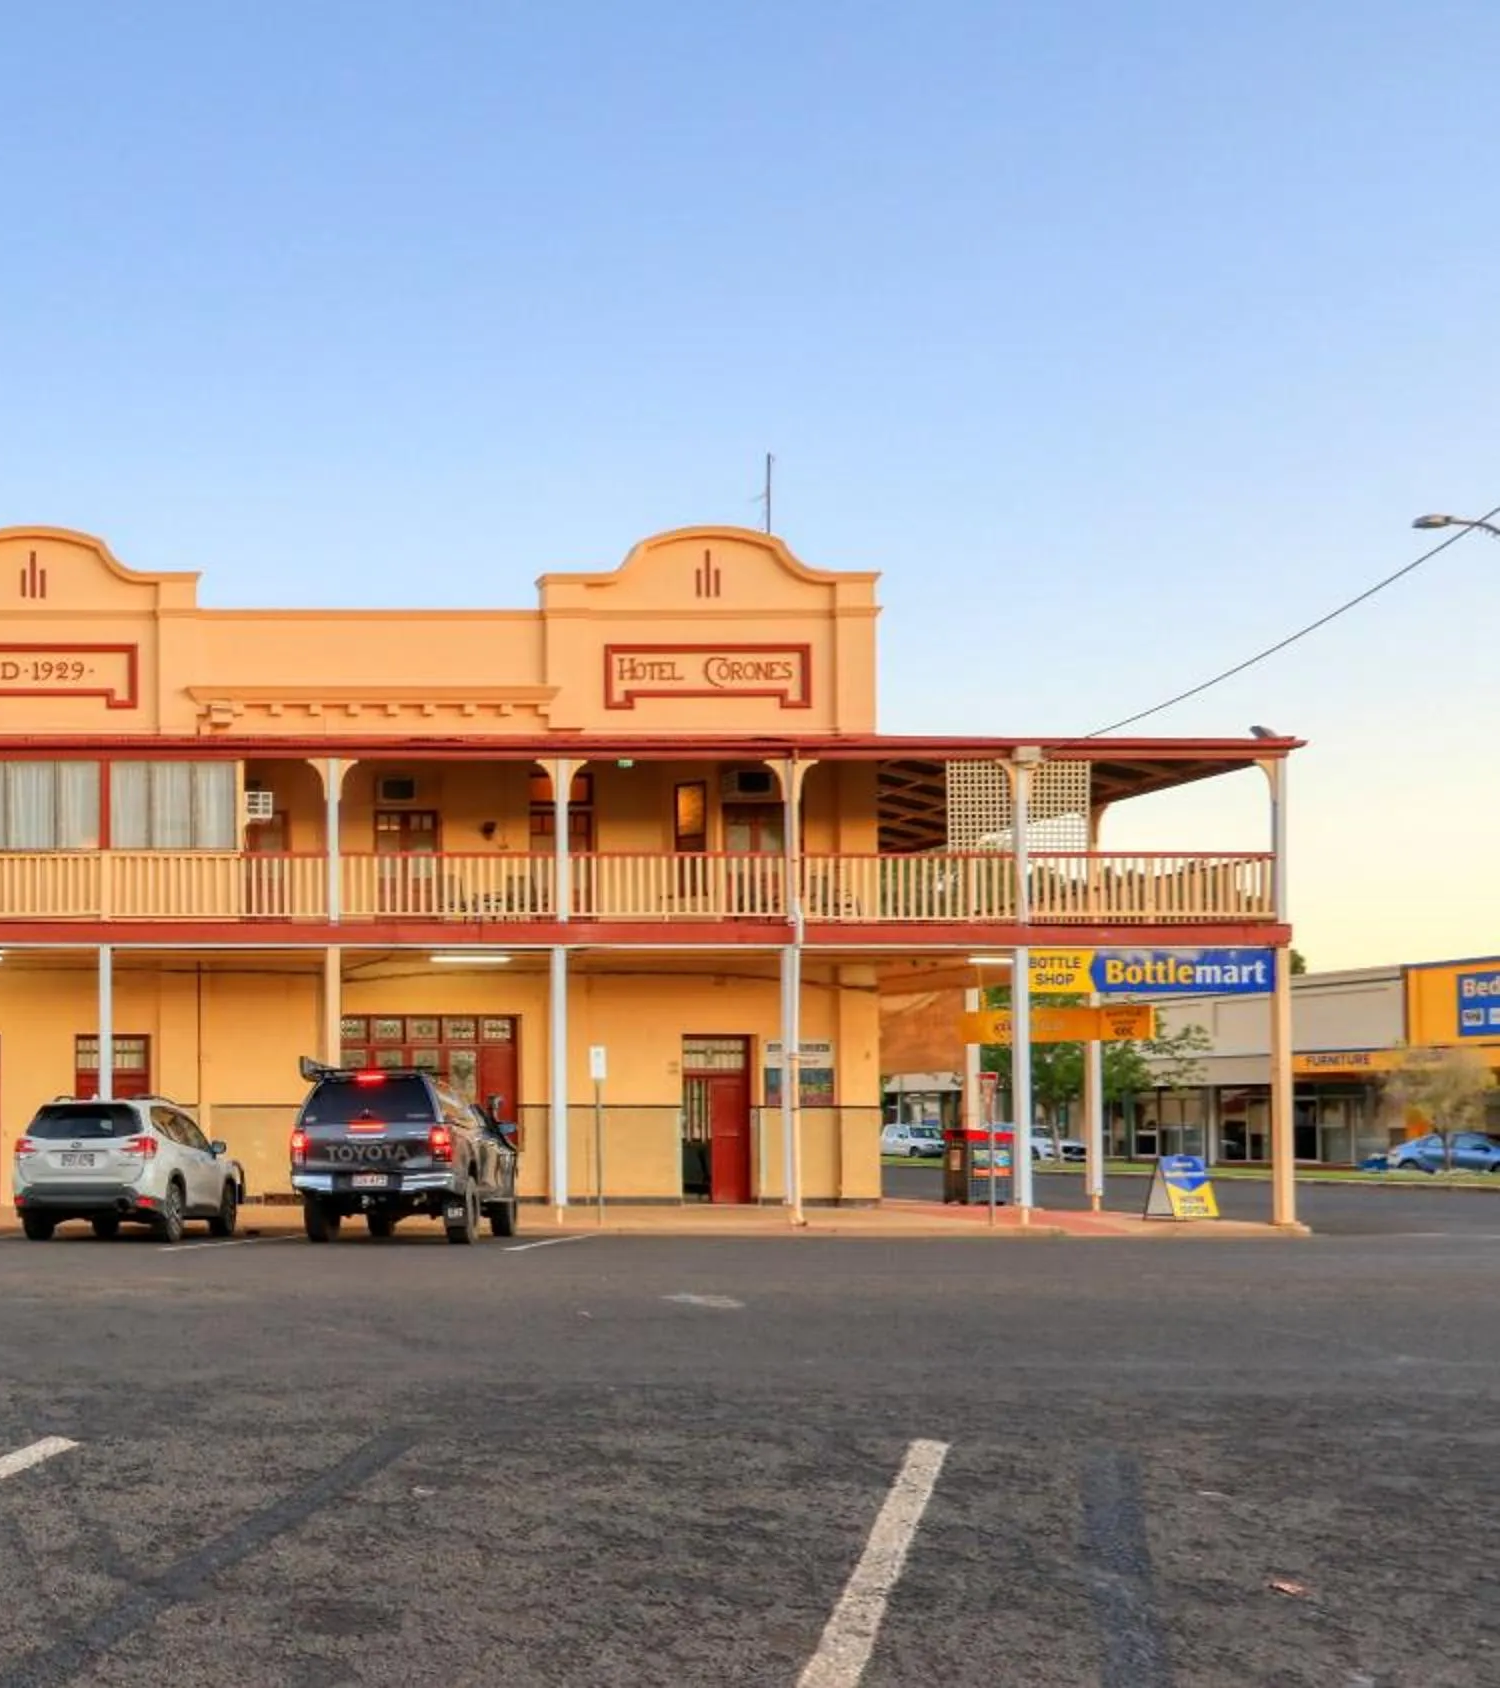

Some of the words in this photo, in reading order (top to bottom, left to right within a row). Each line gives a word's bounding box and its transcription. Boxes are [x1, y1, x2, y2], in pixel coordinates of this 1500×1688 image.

[617, 657, 684, 681] HOTEL
[703, 656, 793, 688] CORONES
[1035, 973, 1075, 986] SHOP
[1105, 958, 1267, 985] Bottlemart
[326, 1145, 411, 1162] TOYOTA
